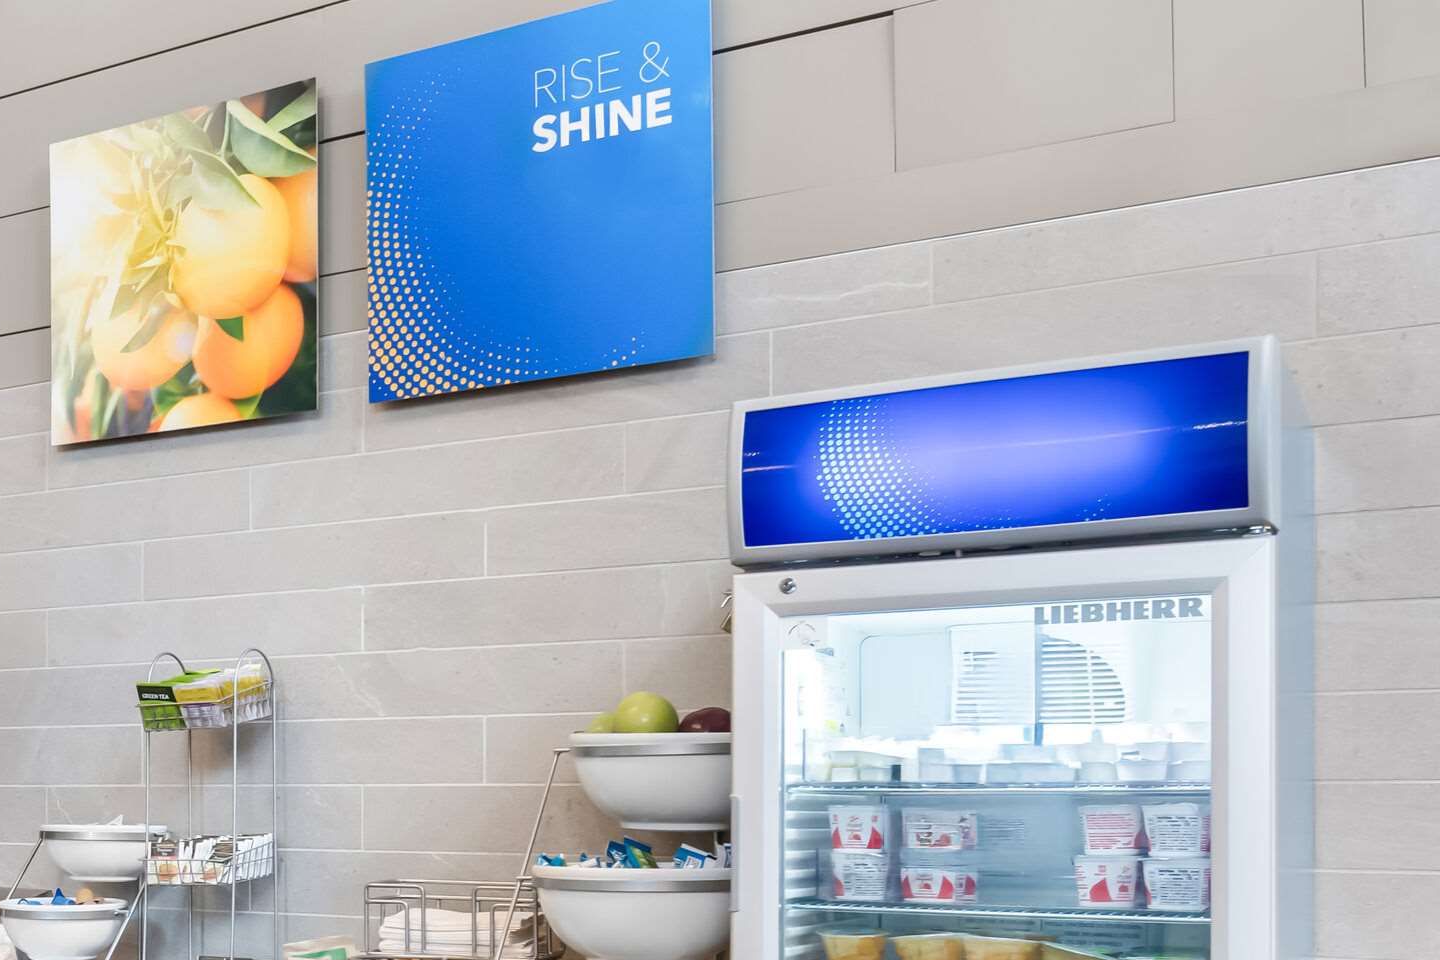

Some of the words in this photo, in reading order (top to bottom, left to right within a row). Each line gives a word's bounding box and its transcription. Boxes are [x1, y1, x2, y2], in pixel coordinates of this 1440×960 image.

[534, 50, 622, 108] RISE
[639, 41, 670, 83] &
[532, 87, 673, 153] SHINE
[1034, 597, 1203, 625] LIEBHERR
